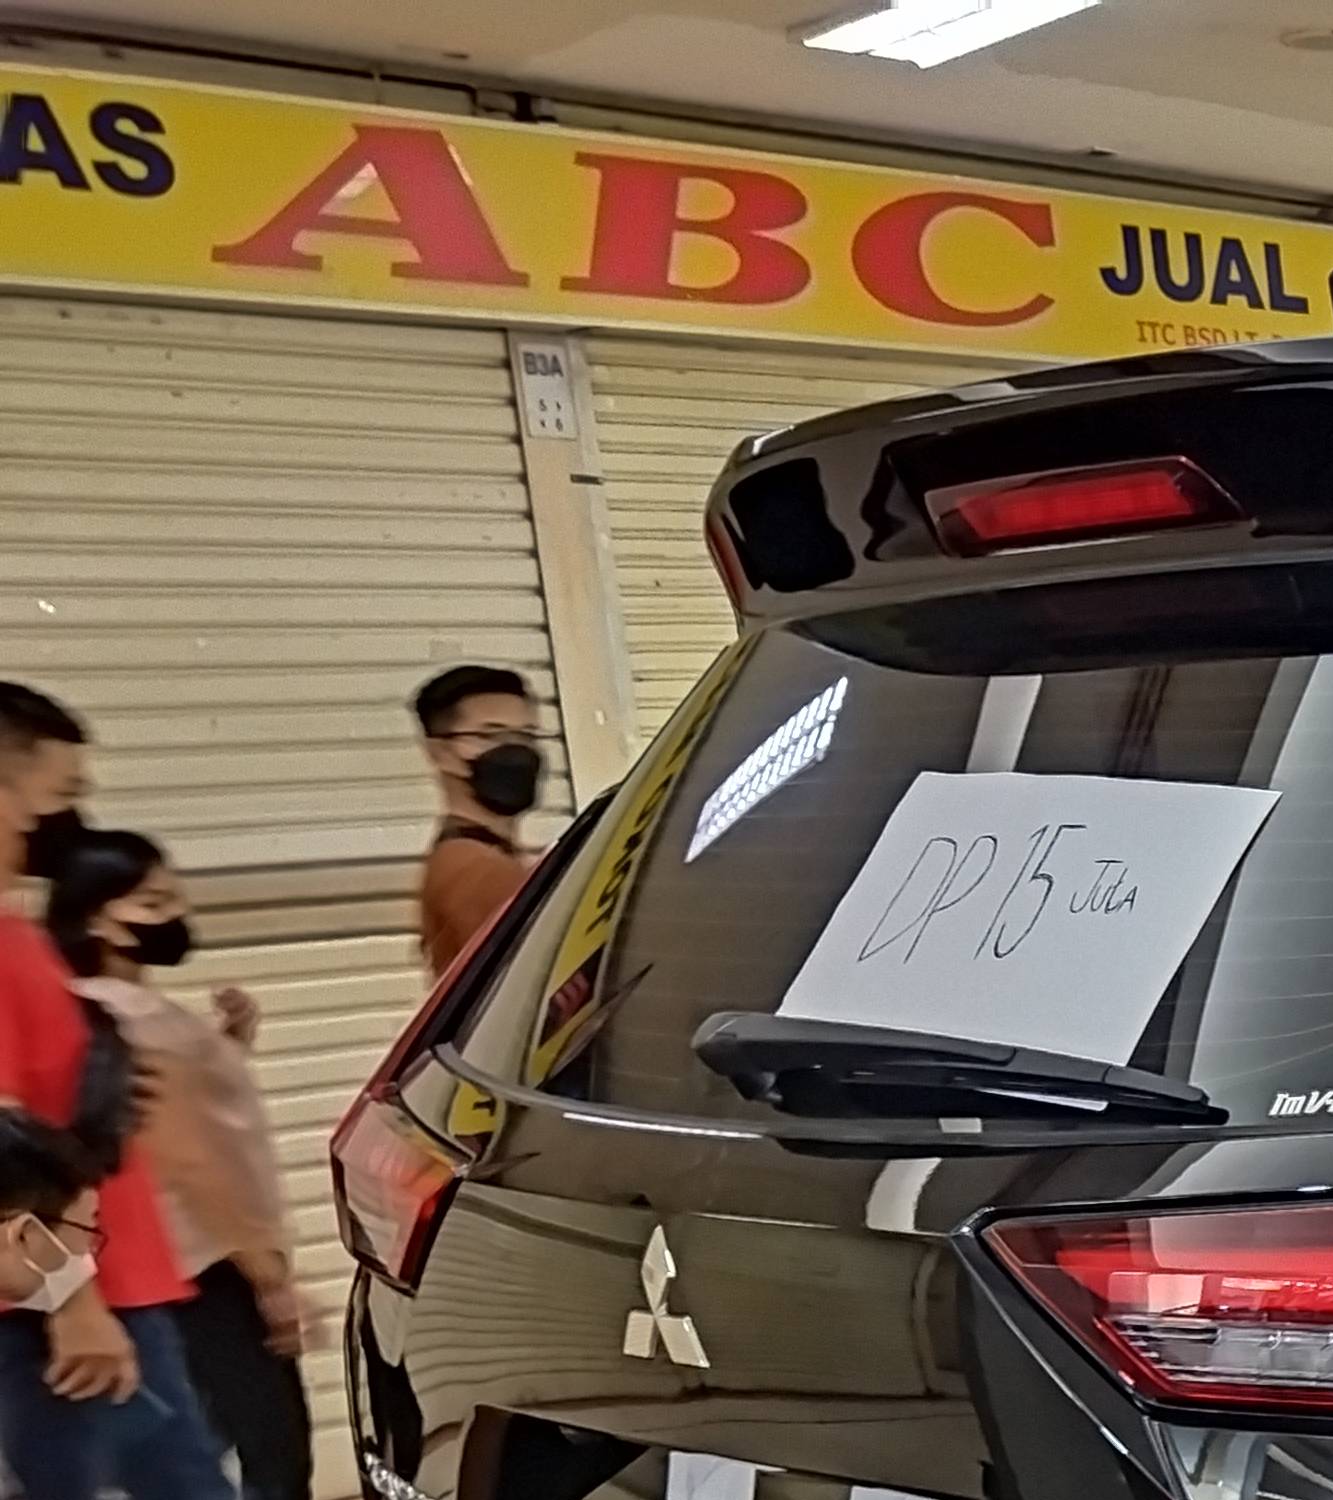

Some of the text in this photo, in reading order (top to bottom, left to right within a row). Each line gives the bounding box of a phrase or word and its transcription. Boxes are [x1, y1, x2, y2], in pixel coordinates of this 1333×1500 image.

[211, 123, 1056, 328] ABC
[1100, 224, 1310, 314] JUAL
[1136, 319, 1176, 346] ITC
[856, 834, 999, 965] DP
[972, 823, 1088, 960] 15
